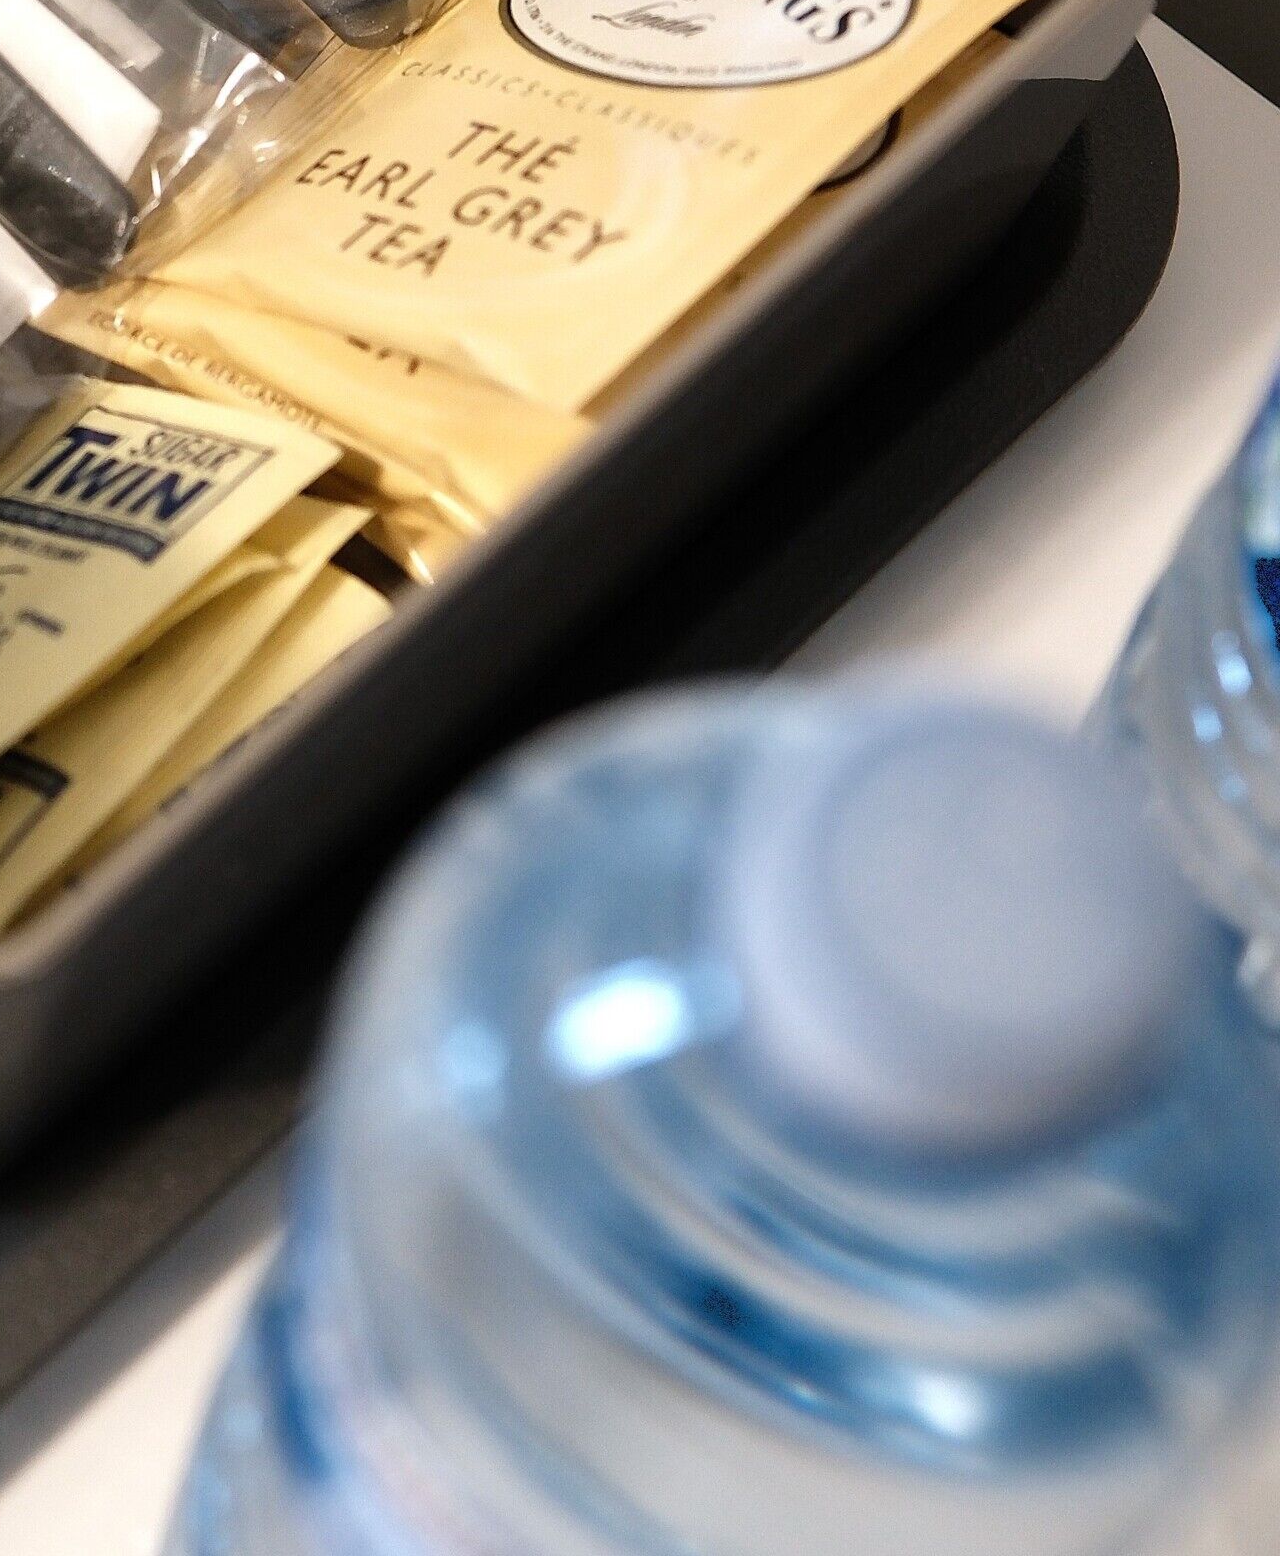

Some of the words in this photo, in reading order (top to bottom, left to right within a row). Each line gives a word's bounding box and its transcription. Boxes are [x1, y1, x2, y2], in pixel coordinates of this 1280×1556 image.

[446, 118, 579, 186] THÉ
[295, 147, 436, 211] EARL
[451, 184, 628, 265] GREY
[339, 212, 452, 279] TEA
[24, 426, 213, 522] TWIN
